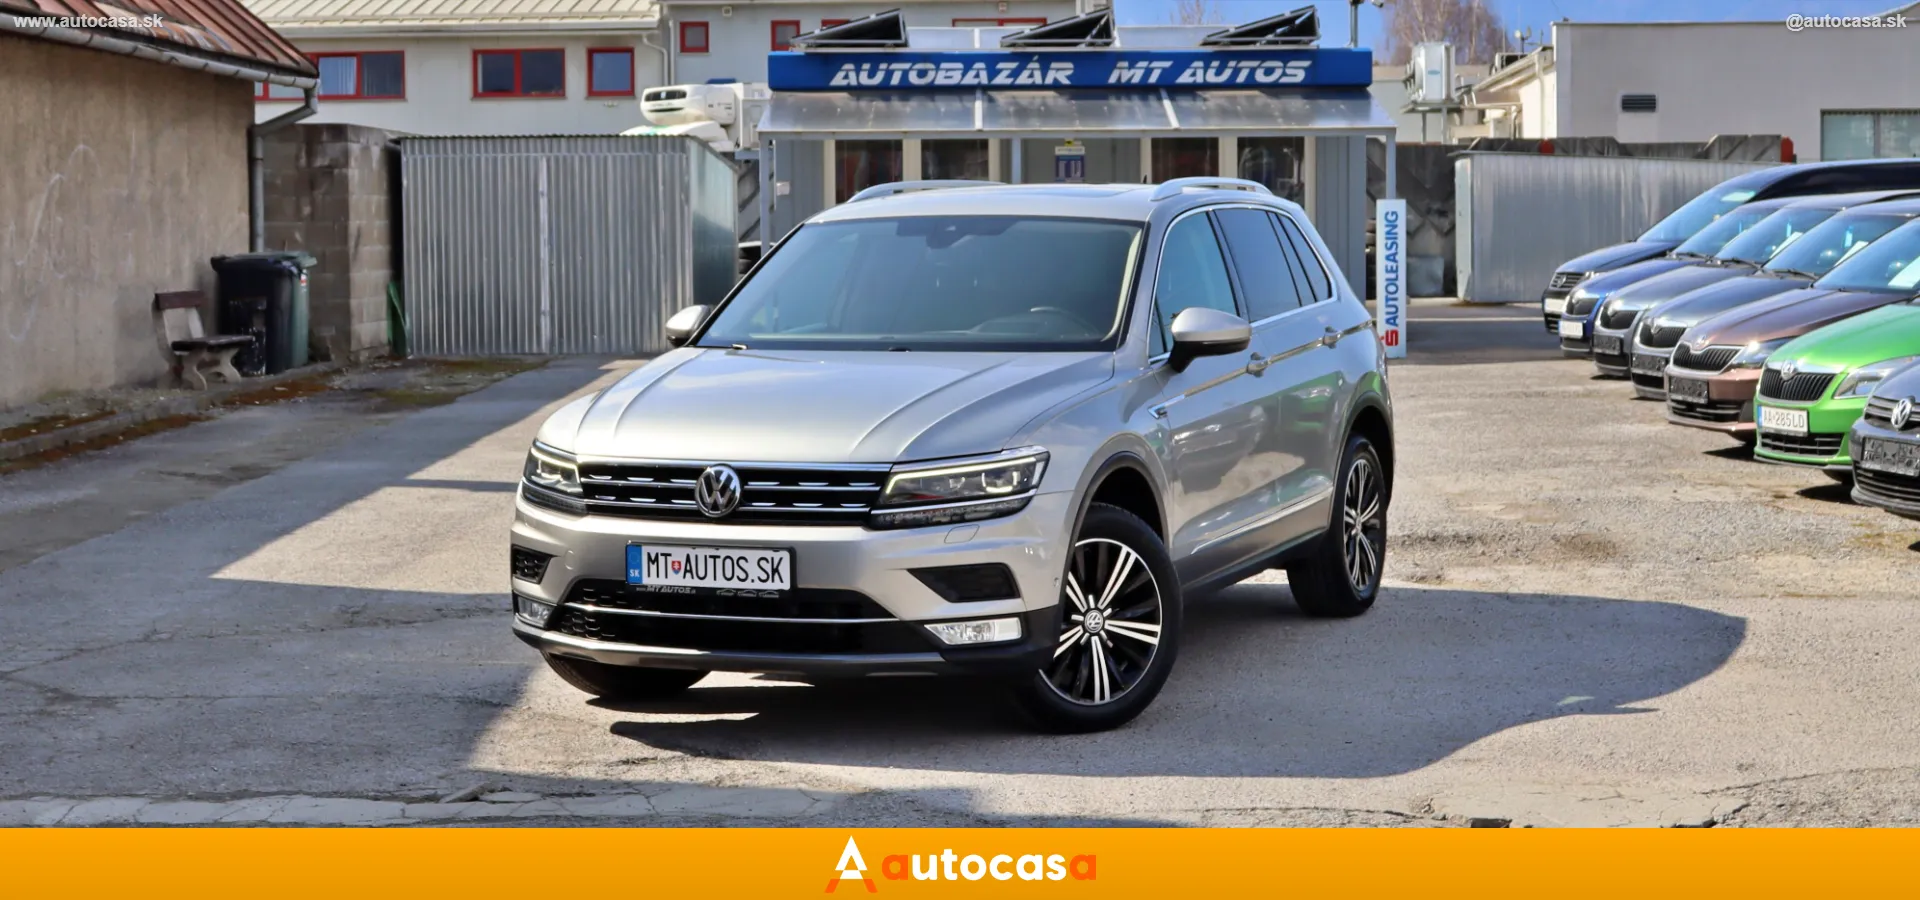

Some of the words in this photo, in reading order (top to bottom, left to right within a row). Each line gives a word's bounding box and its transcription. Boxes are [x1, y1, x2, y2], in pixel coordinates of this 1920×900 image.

[829, 55, 1074, 86] AUTOBAZÁR
[1107, 60, 1173, 84] MT
[1175, 60, 1313, 84] AUTOS
[1384, 210, 1399, 327] AUTOLEASING
[683, 553, 785, 584] AUTOS.SK
